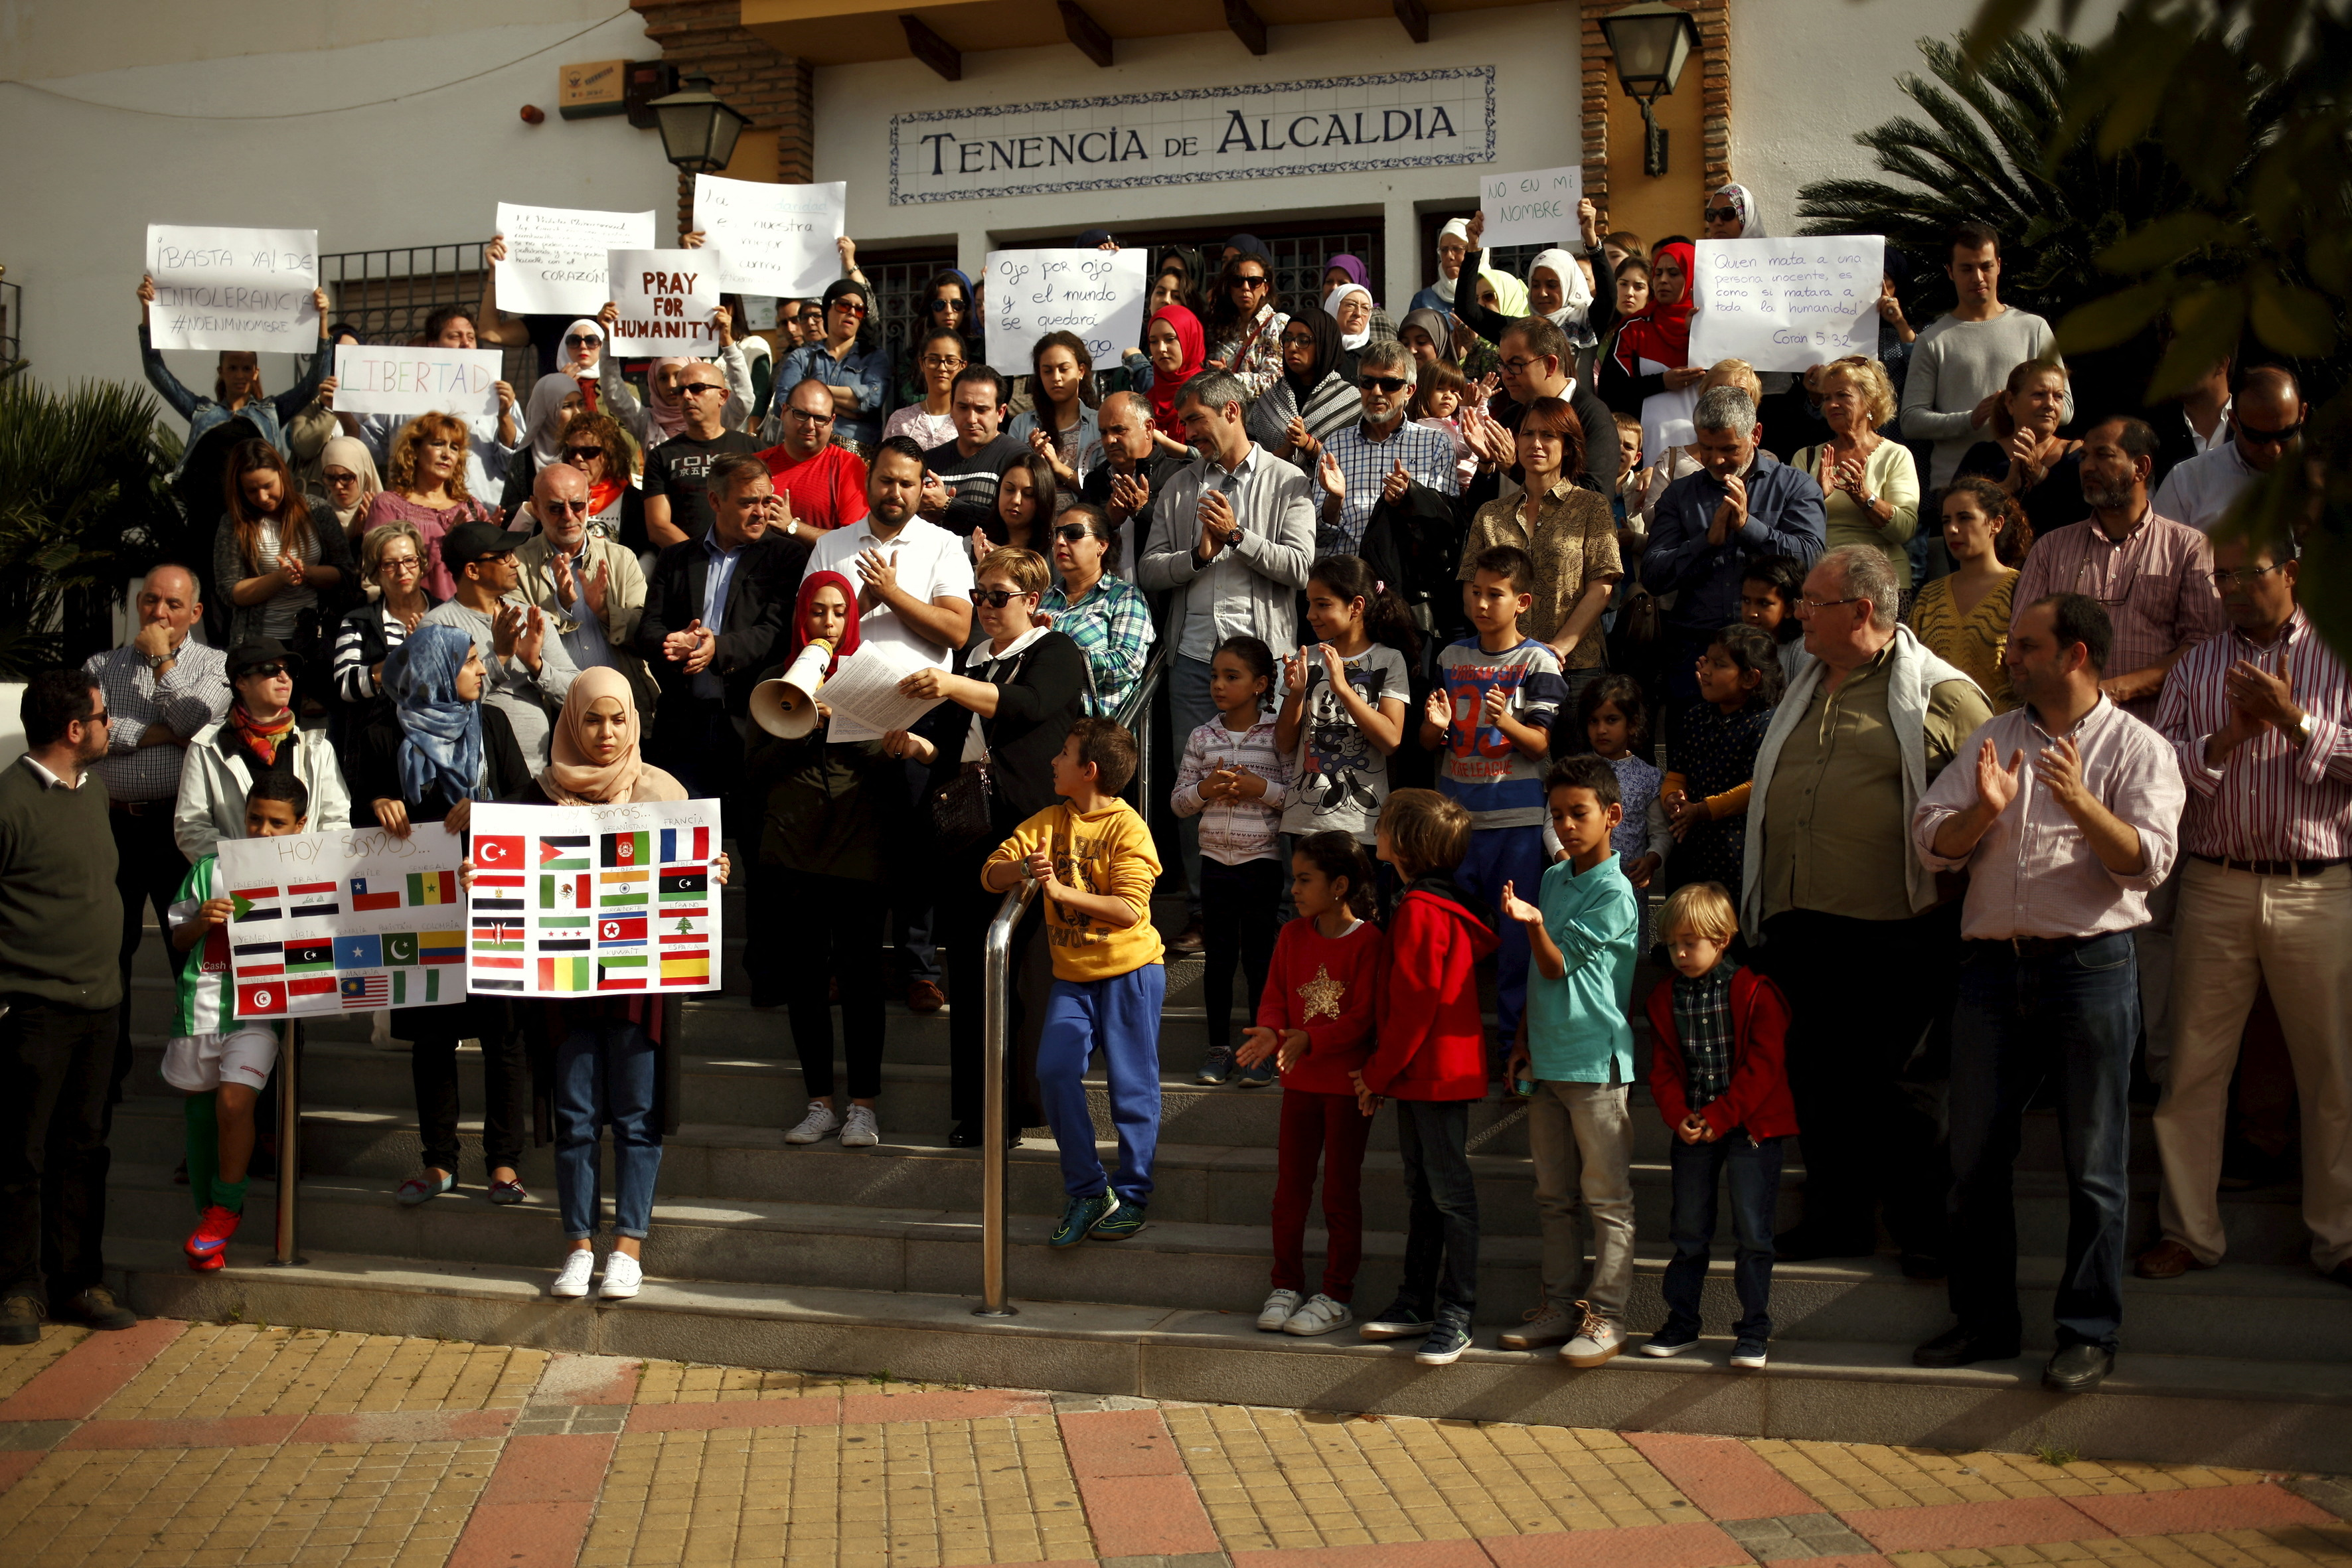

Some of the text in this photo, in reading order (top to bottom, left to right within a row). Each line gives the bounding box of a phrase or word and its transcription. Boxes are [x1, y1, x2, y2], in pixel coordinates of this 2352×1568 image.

[1164, 136, 1199, 158] DE
[1216, 106, 1457, 154] ALCALDIA
[1488, 181, 1507, 199] NO
[1520, 179, 1539, 193] EN
[1500, 200, 1563, 223] NOMBRE
[250, 248, 276, 274] YA!
[284, 253, 313, 270] DE
[1768, 251, 1806, 266] mata
[1816, 256, 1828, 265] a
[1837, 254, 1862, 264] una
[1000, 260, 1029, 285] Ojo
[1714, 274, 1763, 289] persona
[1839, 271, 1853, 279] es
[642, 271, 699, 295] PRAY
[1715, 289, 1749, 297] como
[1784, 286, 1833, 297] matara
[1843, 288, 1855, 297] a
[653, 297, 684, 317] FOR
[1001, 281, 1117, 315] y el mundo
[1715, 301, 1744, 312] toda
[1760, 301, 1774, 313] la
[613, 319, 718, 341] HUMANITY
[1000, 309, 1099, 335] se quedará
[341, 358, 491, 394] LIBERTAD
[670, 453, 721, 471] TOK
[1450, 664, 1496, 681] URBAN
[1471, 759, 1514, 777] LEAGUE
[409, 862, 448, 872] SENEGAL
[293, 874, 323, 884] IRAK
[238, 933, 272, 944] YEMEN
[1047, 923, 1112, 949] WOLF
[202, 961, 226, 971] Cash
